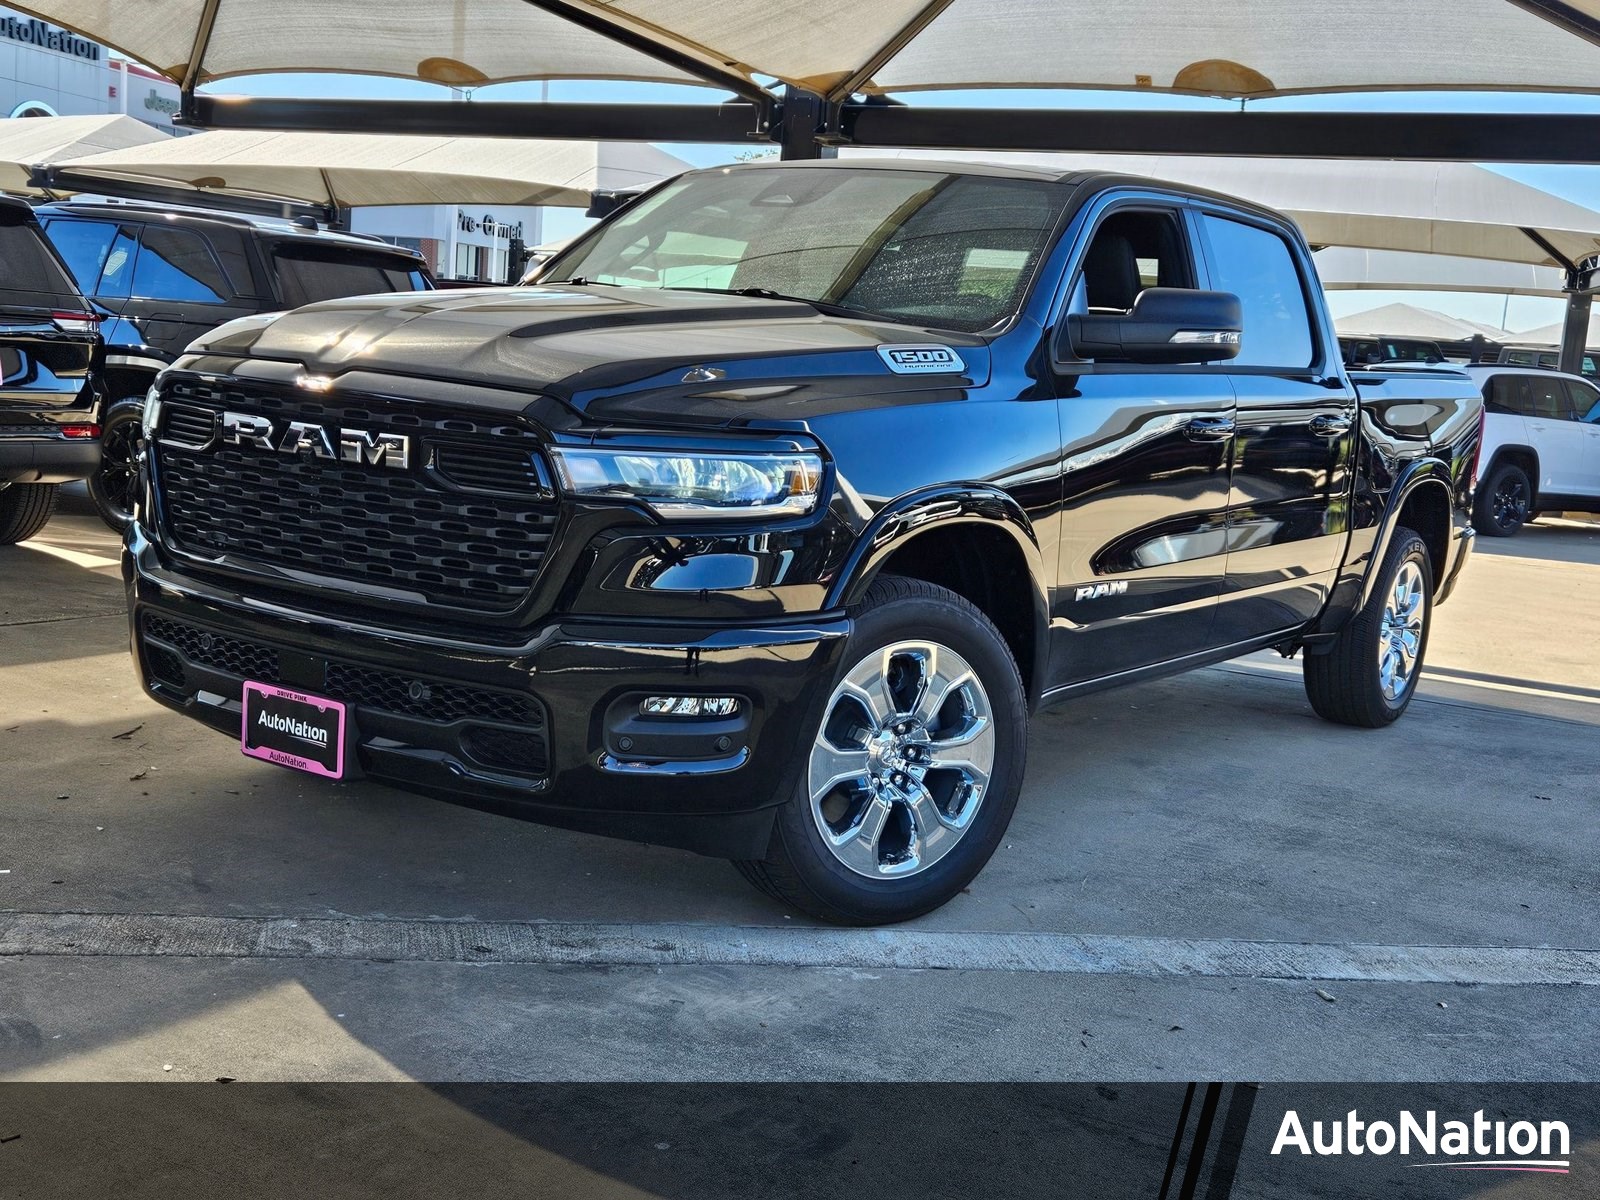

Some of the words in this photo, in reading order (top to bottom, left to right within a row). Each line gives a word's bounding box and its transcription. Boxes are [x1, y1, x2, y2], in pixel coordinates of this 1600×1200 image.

[0, 16, 100, 61] utoNation
[890, 350, 949, 362] 1500
[223, 411, 409, 470] RAM
[1074, 580, 1129, 602] RAM
[276, 689, 293, 700] DRIVE
[294, 694, 308, 703] PINK
[258, 709, 328, 743] AutoNation
